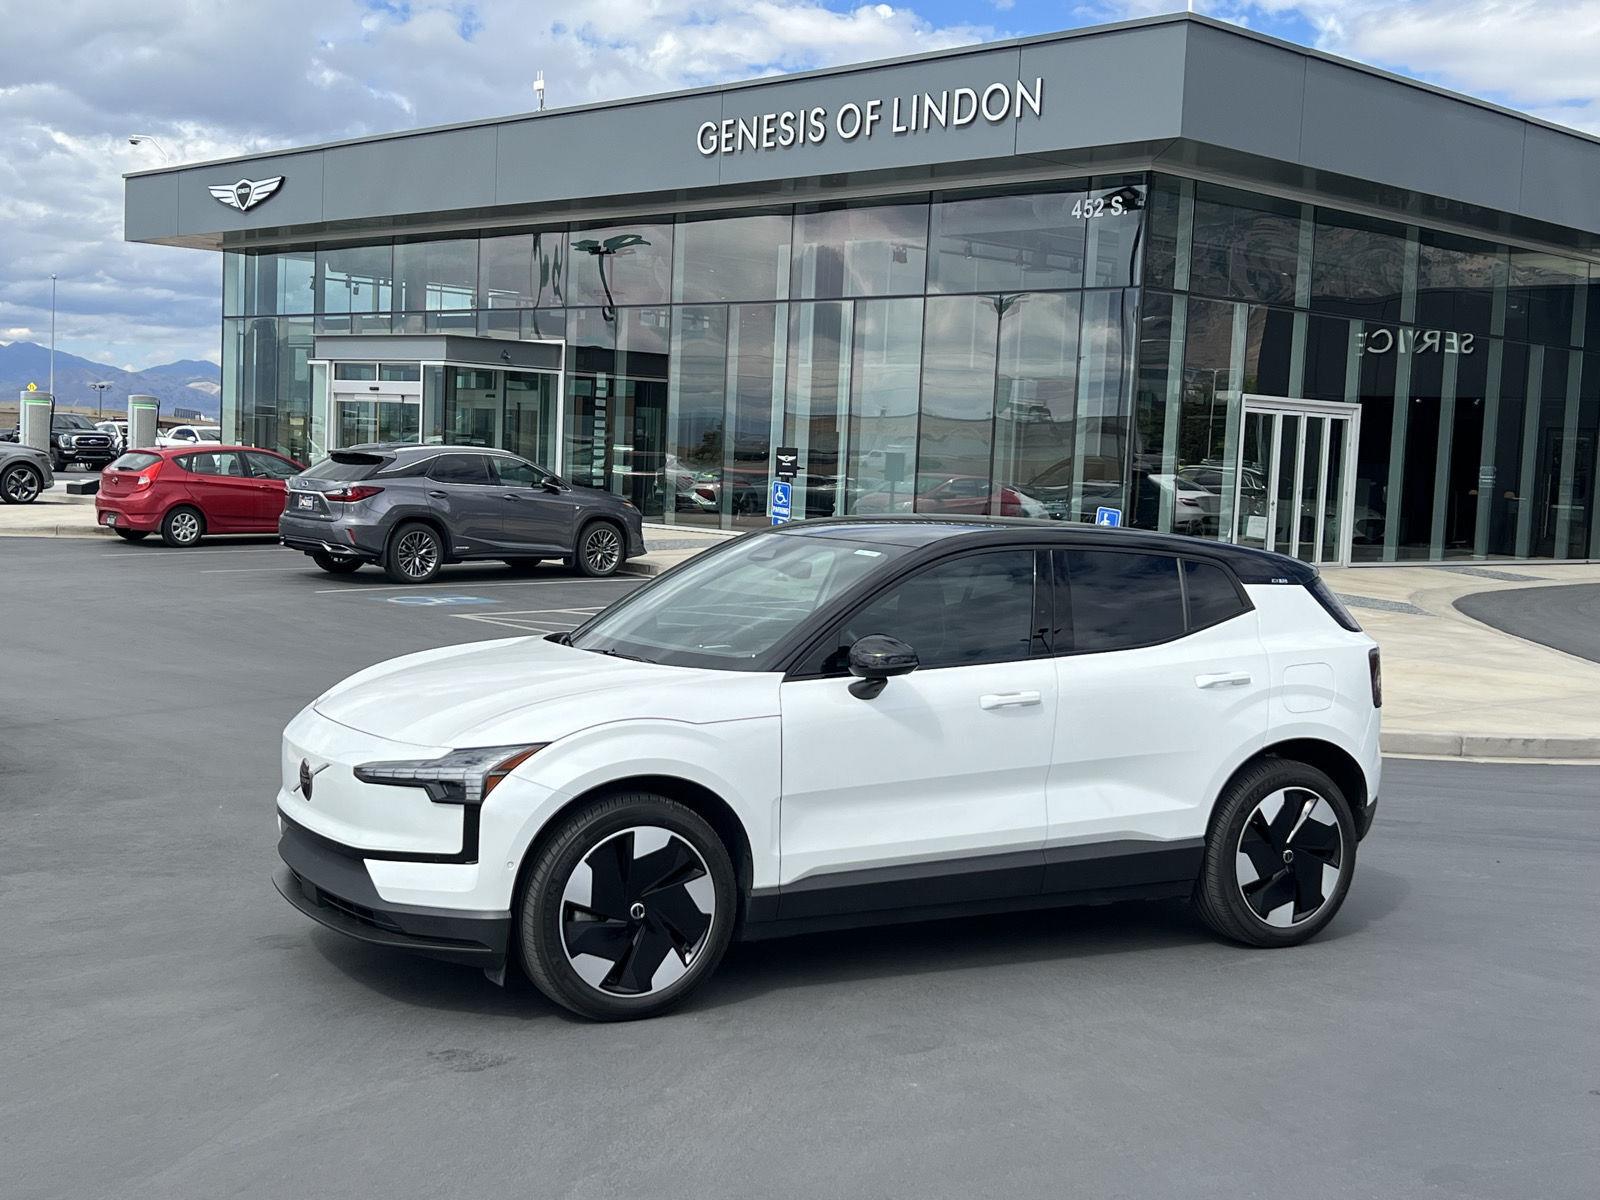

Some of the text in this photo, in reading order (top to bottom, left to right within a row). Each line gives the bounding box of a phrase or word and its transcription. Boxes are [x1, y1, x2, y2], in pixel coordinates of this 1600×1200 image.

[696, 77, 1043, 155] GENESIS OF LINDON
[1071, 195, 1128, 219] 452 S.
